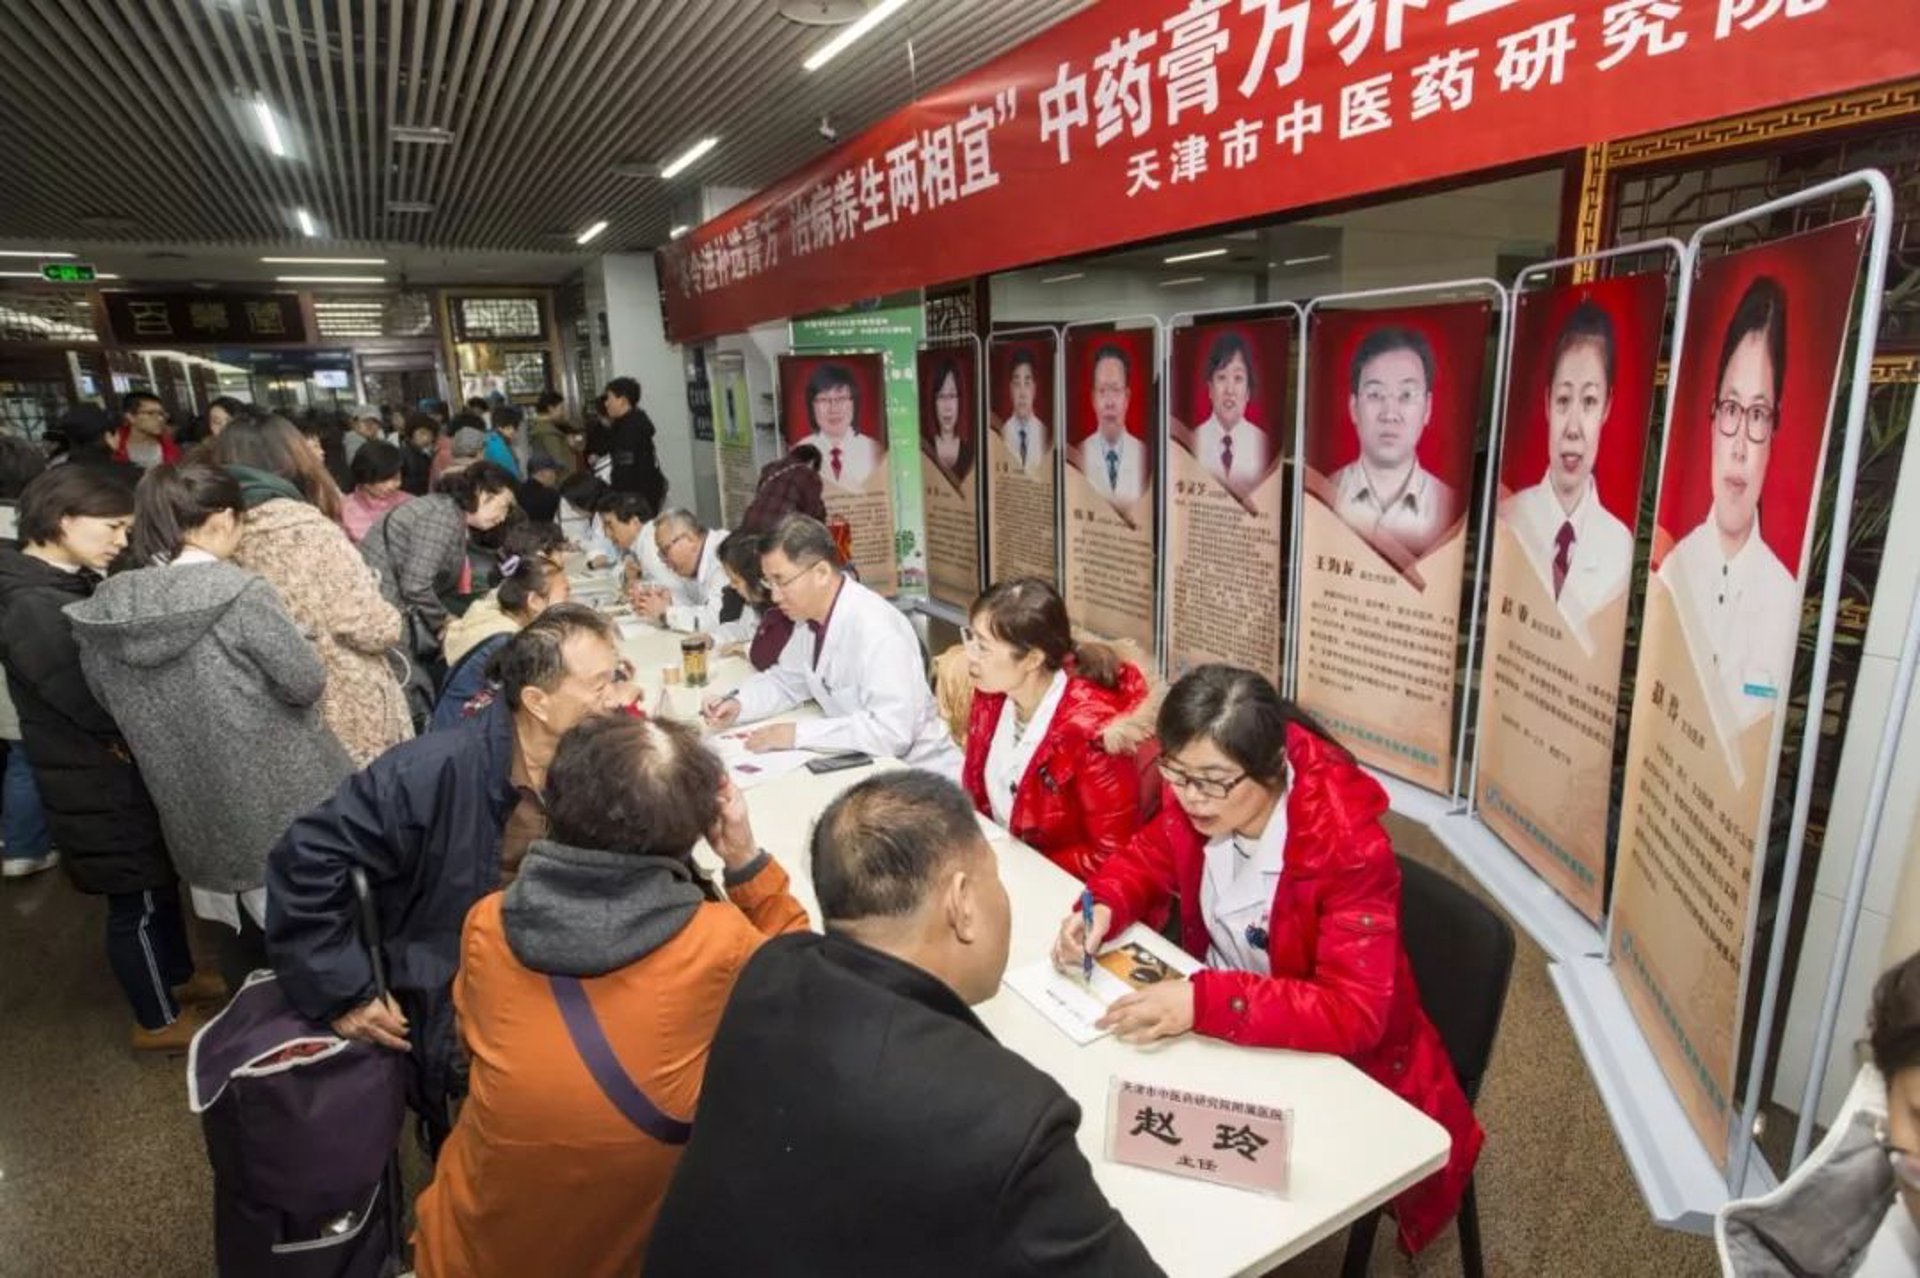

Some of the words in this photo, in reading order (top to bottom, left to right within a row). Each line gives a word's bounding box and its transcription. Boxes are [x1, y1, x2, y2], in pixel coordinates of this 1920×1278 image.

[1038, 0, 1512, 164] 中药膏方
[1130, 1106, 1269, 1162] 赵玲
[1175, 1154, 1219, 1172] 主任
